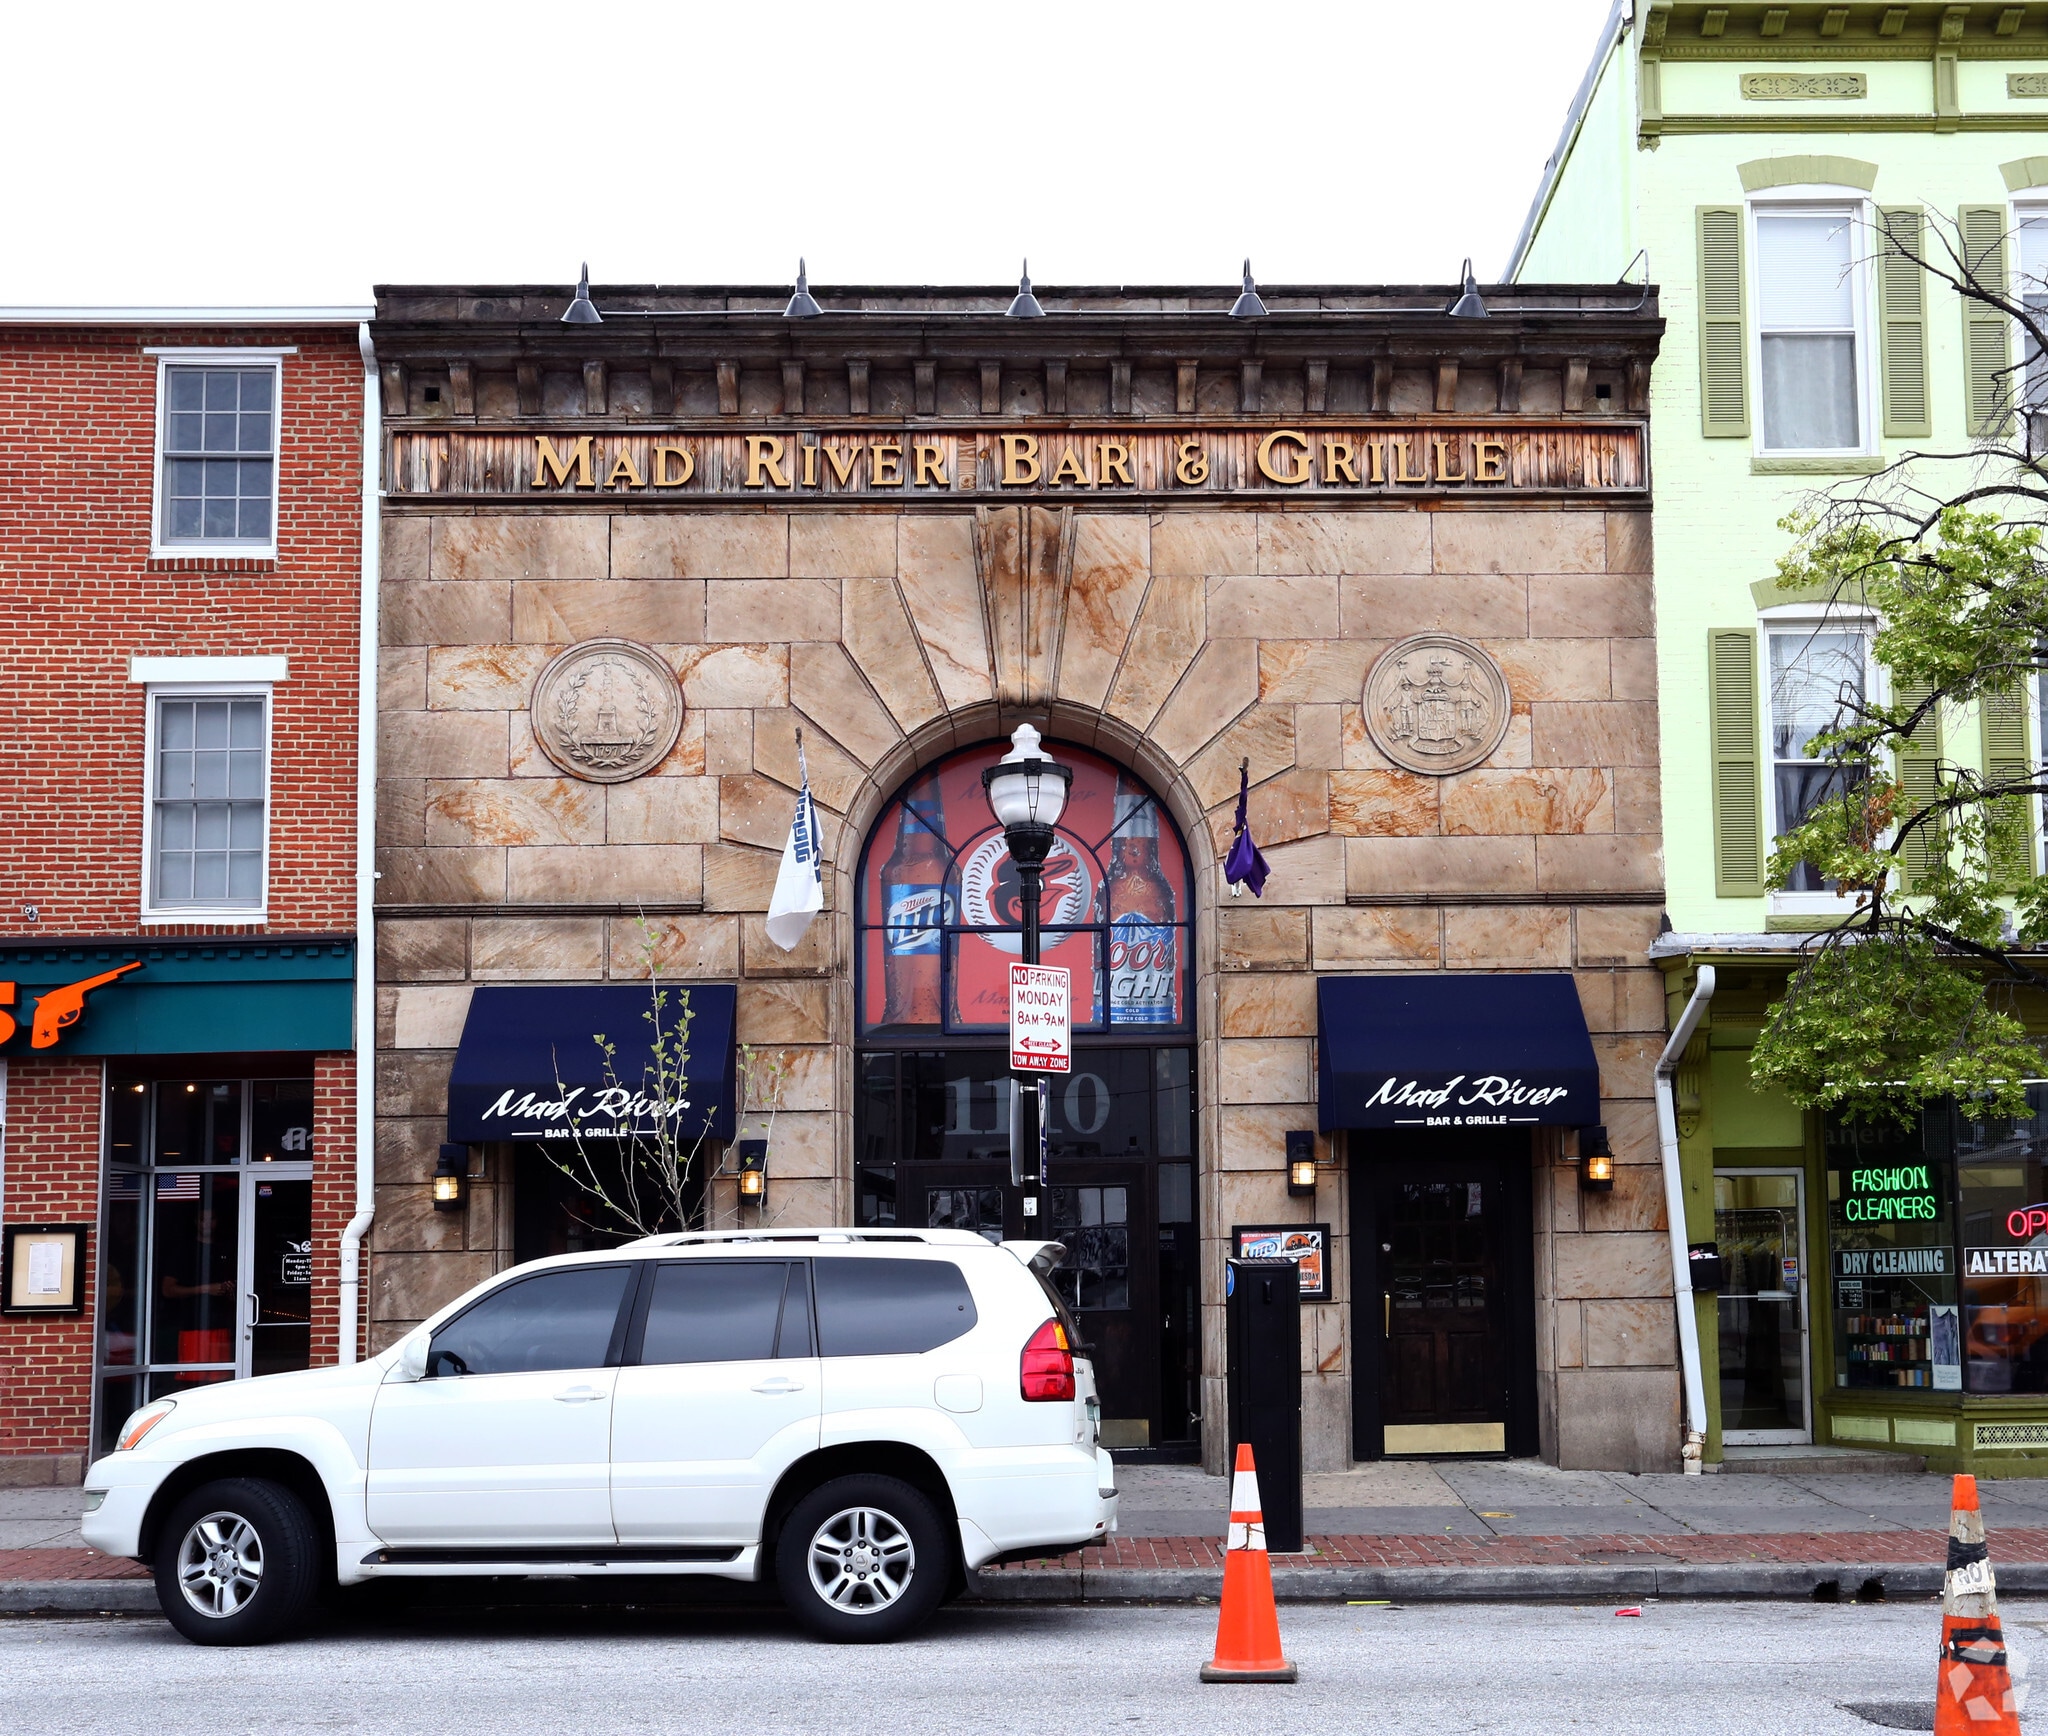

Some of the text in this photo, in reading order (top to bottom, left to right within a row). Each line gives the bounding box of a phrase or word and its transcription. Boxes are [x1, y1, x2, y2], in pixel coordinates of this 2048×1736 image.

[531, 429, 1507, 488] MAD RIVER BAR & GRILLE
[594, 745, 619, 758] 1797
[901, 896, 935, 912] Miller
[1013, 968, 1067, 989] NO PARKING
[1091, 971, 1174, 999] LGHT
[1017, 989, 1064, 1007] MONDAY
[1017, 1010, 1066, 1027] 8AM-9AM
[1039, 1041, 1058, 1049] CLEANING
[1013, 1054, 1068, 1069] TOW AWAY ZONE
[1365, 1075, 1568, 1109] Mad River
[481, 1086, 691, 1121] Mad River
[1426, 1115, 1507, 1126] BAR & GRILLE
[544, 1127, 628, 1138] BAR & GRILLE
[1852, 1165, 1929, 1192] FASHION
[1846, 1195, 1936, 1221] CLEANERS
[2006, 1210, 2048, 1237] OP
[1842, 1249, 1945, 1274] DRY CLEANING
[1970, 1250, 2048, 1273] ALTERA
